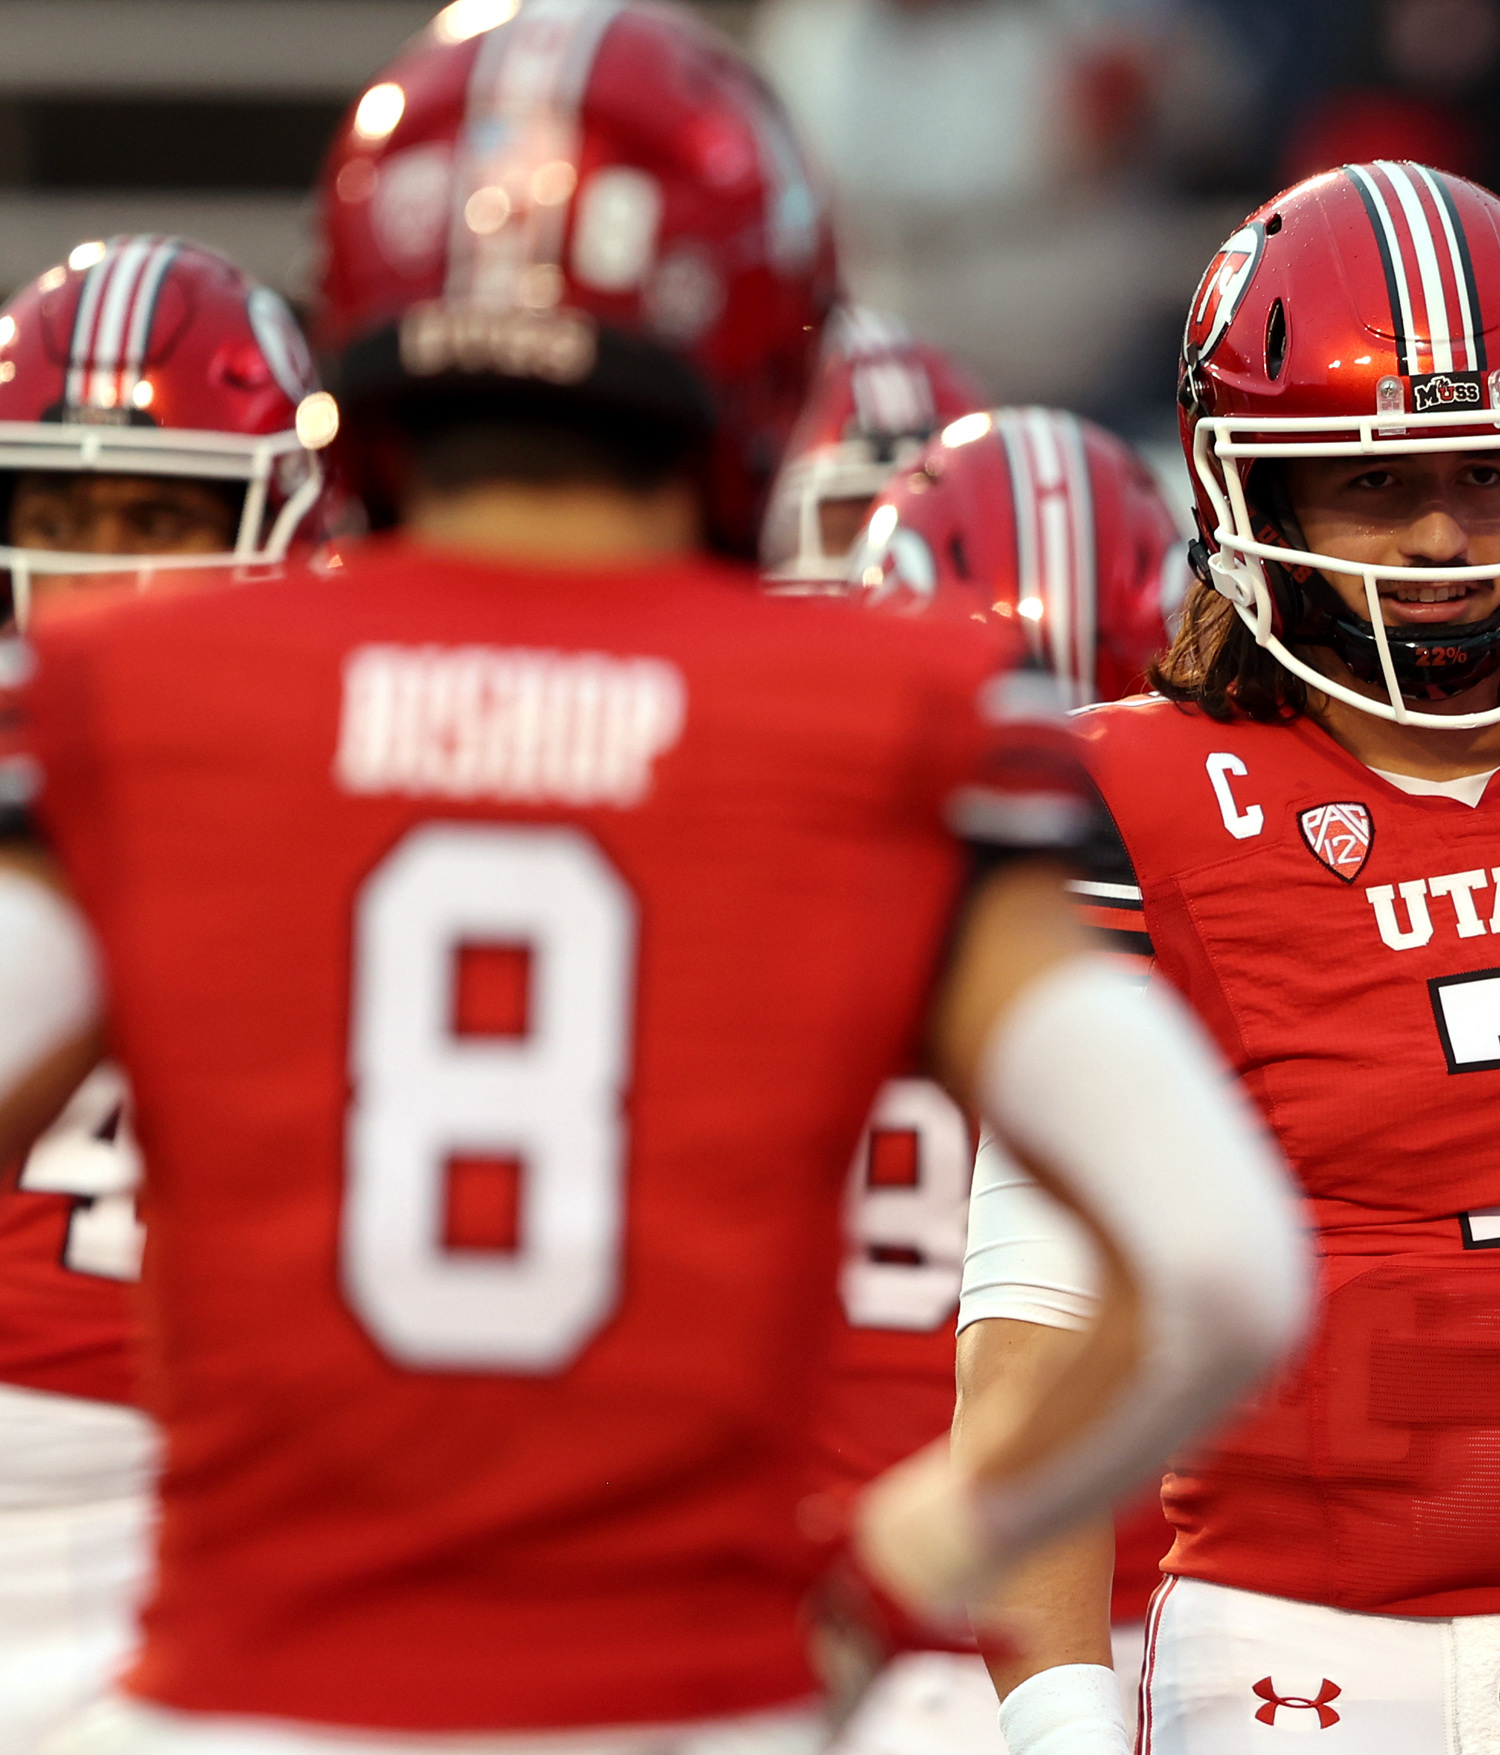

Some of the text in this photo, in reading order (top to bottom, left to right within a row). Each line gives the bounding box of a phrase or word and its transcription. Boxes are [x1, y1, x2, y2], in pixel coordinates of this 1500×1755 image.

[1415, 646, 1468, 667] 22%
[337, 645, 686, 806] BISHOP
[1206, 752, 1264, 839] C
[1302, 804, 1370, 853] PAC
[1324, 835, 1362, 866] 12
[340, 820, 637, 1375] 8
